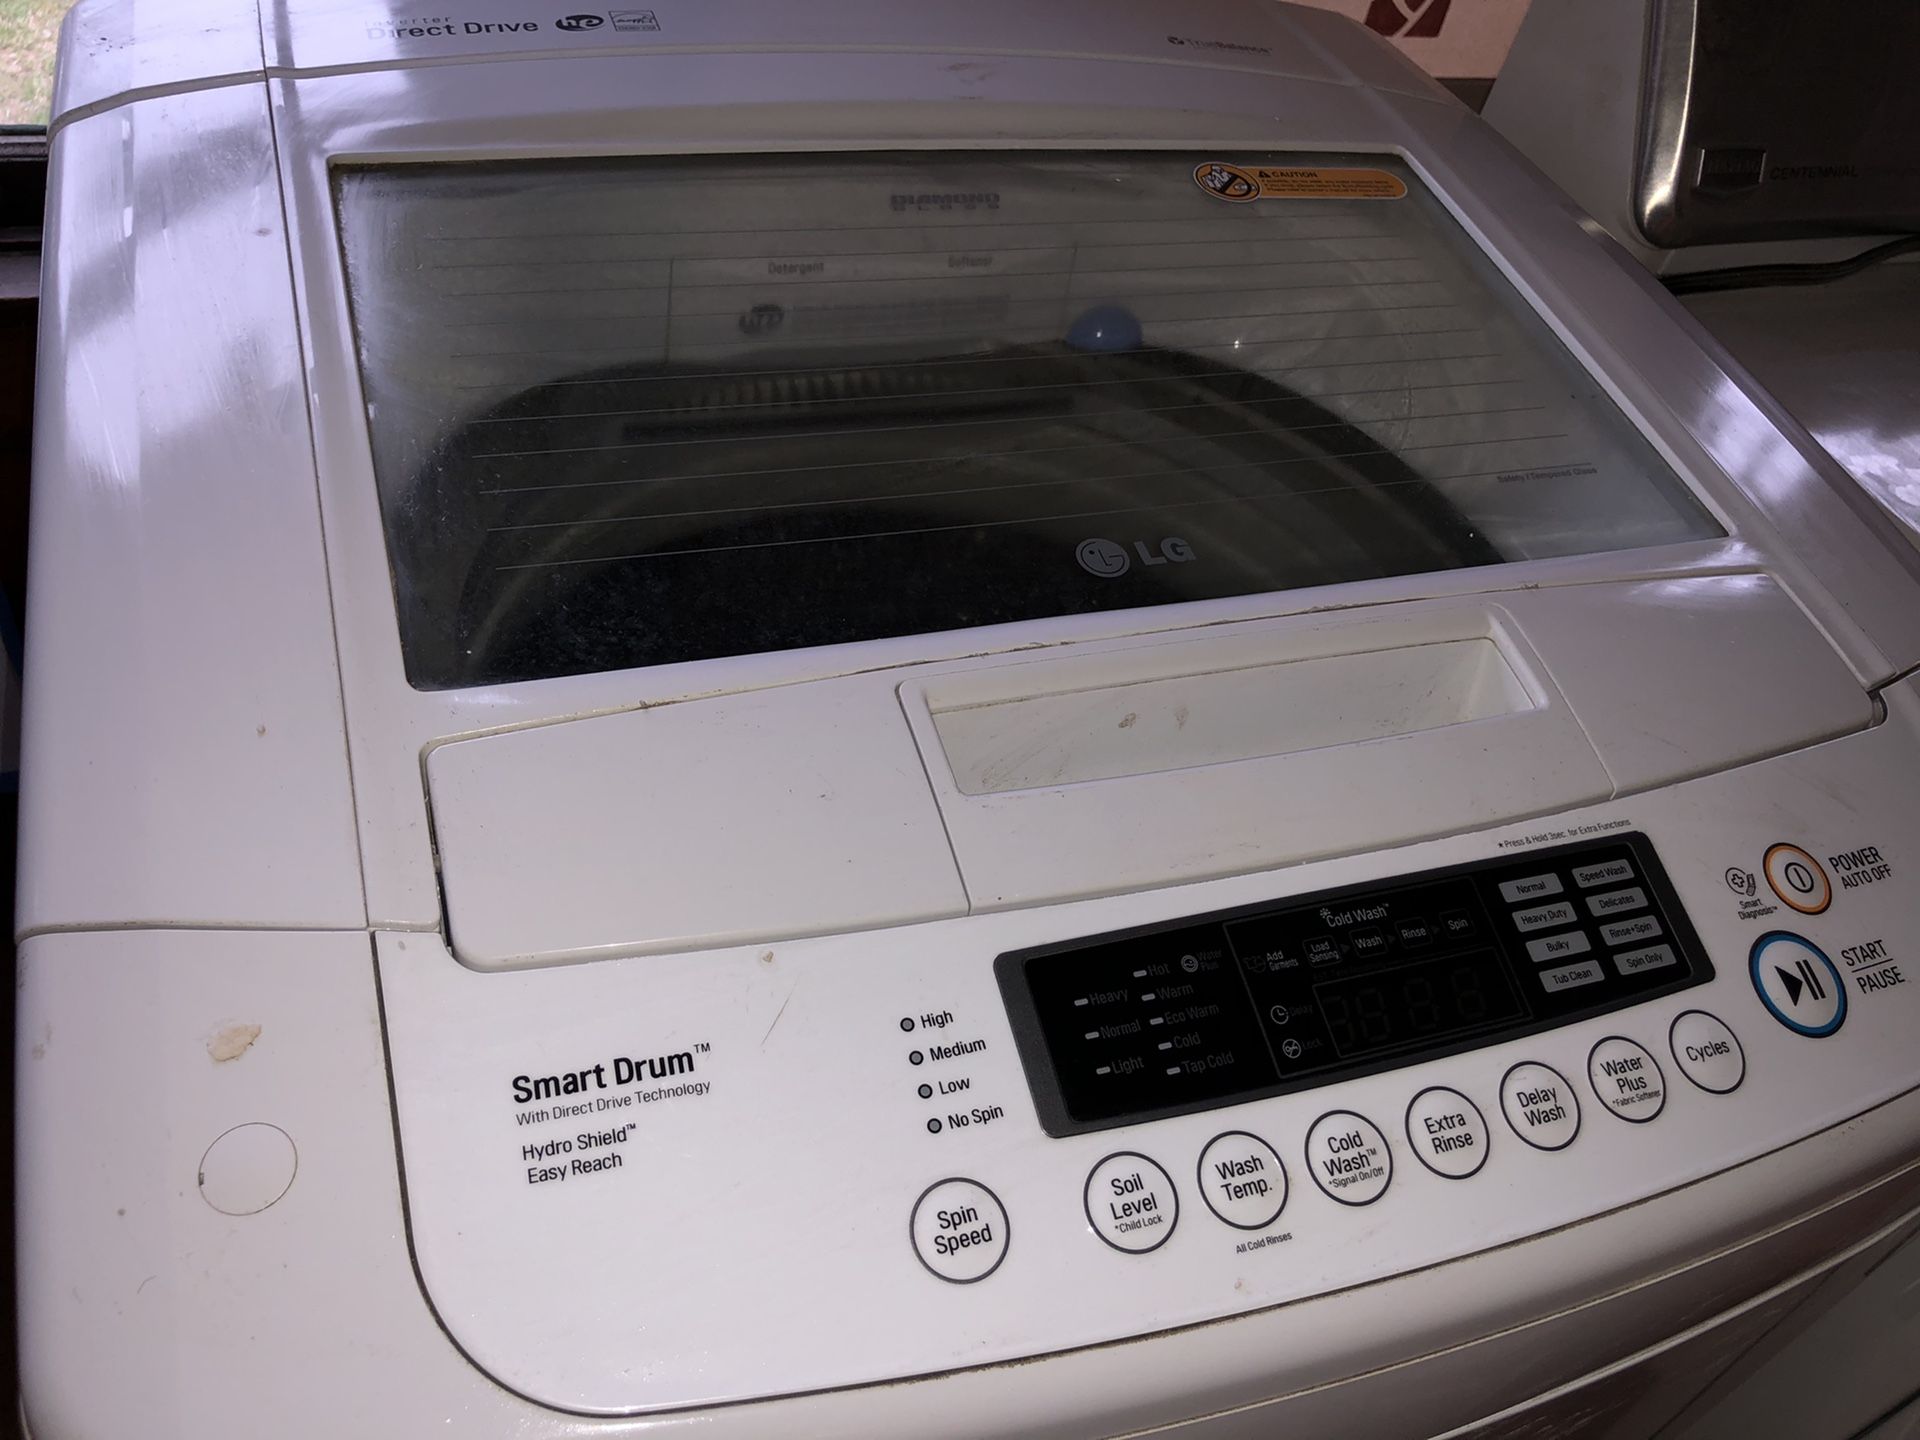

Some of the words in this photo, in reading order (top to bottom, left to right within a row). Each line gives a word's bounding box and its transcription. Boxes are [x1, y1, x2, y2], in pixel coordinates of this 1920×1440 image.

[366, 24, 456, 40] Direct
[463, 20, 539, 34] Drive
[1769, 165, 1859, 180] CENTENNIAL
[768, 262, 824, 275] Detergent
[1136, 536, 1196, 567] LG
[1505, 837, 1525, 848] Press
[1525, 836, 1532, 844] &
[1533, 832, 1548, 843] Hold
[1568, 828, 1578, 837] for
[1578, 824, 1598, 835] Extra
[1597, 819, 1631, 832] Functions
[1828, 846, 1884, 873] POWER
[1579, 867, 1604, 882] Speed
[1605, 865, 1627, 877] Wash
[1840, 870, 1872, 890] AUTO
[1872, 864, 1892, 881] OFF
[1516, 881, 1546, 895] Normal
[1599, 893, 1635, 909] Delicates
[1739, 898, 1763, 909] Smart
[1326, 912, 1353, 928] Cold
[1448, 917, 1469, 931] Spin
[1520, 911, 1547, 925] Heavy
[1548, 907, 1568, 920] Duty
[1401, 926, 1426, 939] Rinse
[1609, 922, 1653, 939] Rinse+Spin
[1311, 941, 1330, 953] Load
[1355, 935, 1383, 949] Wash
[1546, 939, 1569, 953] Bulky
[1266, 950, 1284, 962] Add
[1309, 950, 1340, 963] Sensing
[1626, 956, 1646, 968] Spin
[1646, 953, 1663, 965] Only
[1840, 939, 1888, 967] START
[1148, 962, 1171, 976] Hot
[1269, 958, 1299, 972] Garments
[1552, 973, 1569, 985] Tub
[1569, 968, 1593, 982] Clean
[1856, 966, 1906, 995] PAUSE
[1089, 989, 1129, 1006] Heavy
[1156, 984, 1194, 1000] Warm
[920, 1010, 954, 1029] High
[1165, 1010, 1186, 1025] Eco
[1186, 1003, 1220, 1019] Warm
[1100, 1019, 1141, 1039] Normal
[929, 1038, 987, 1061] Medium
[1174, 1032, 1201, 1049] Cold
[1685, 1040, 1731, 1063] Cycles
[1111, 1056, 1145, 1075] Light
[1181, 1059, 1207, 1075] Tap
[1206, 1051, 1235, 1068] Cold
[1600, 1055, 1643, 1077] Water
[512, 1064, 607, 1104] Smart
[938, 1078, 971, 1094] Low
[1616, 1074, 1648, 1094] Plus
[516, 1108, 549, 1126] With
[552, 1102, 594, 1119] Direct
[596, 1094, 632, 1111] Drive
[634, 1081, 711, 1104] Technology
[1516, 1086, 1558, 1108] Delay
[947, 1113, 970, 1129] No
[970, 1104, 1004, 1124] Spin
[1423, 1113, 1467, 1134] Extra
[1524, 1104, 1567, 1127] Wash
[522, 1140, 573, 1162] Hydro
[1327, 1130, 1364, 1154] Cold
[1431, 1132, 1474, 1154] Rinse
[527, 1165, 568, 1184] Easy
[571, 1152, 623, 1176] Reach
[1214, 1154, 1264, 1181] Wash
[1359, 1166, 1385, 1181] On/Off
[1110, 1173, 1145, 1197] Soil
[1220, 1177, 1273, 1202] Temp.
[1110, 1192, 1158, 1220] Level
[936, 1205, 979, 1231] Spin
[1142, 1213, 1164, 1228] Lock
[933, 1223, 993, 1256] Speed
[1235, 1244, 1247, 1254] All
[1247, 1238, 1266, 1251] Cold
[1265, 1231, 1293, 1246] Rinses
